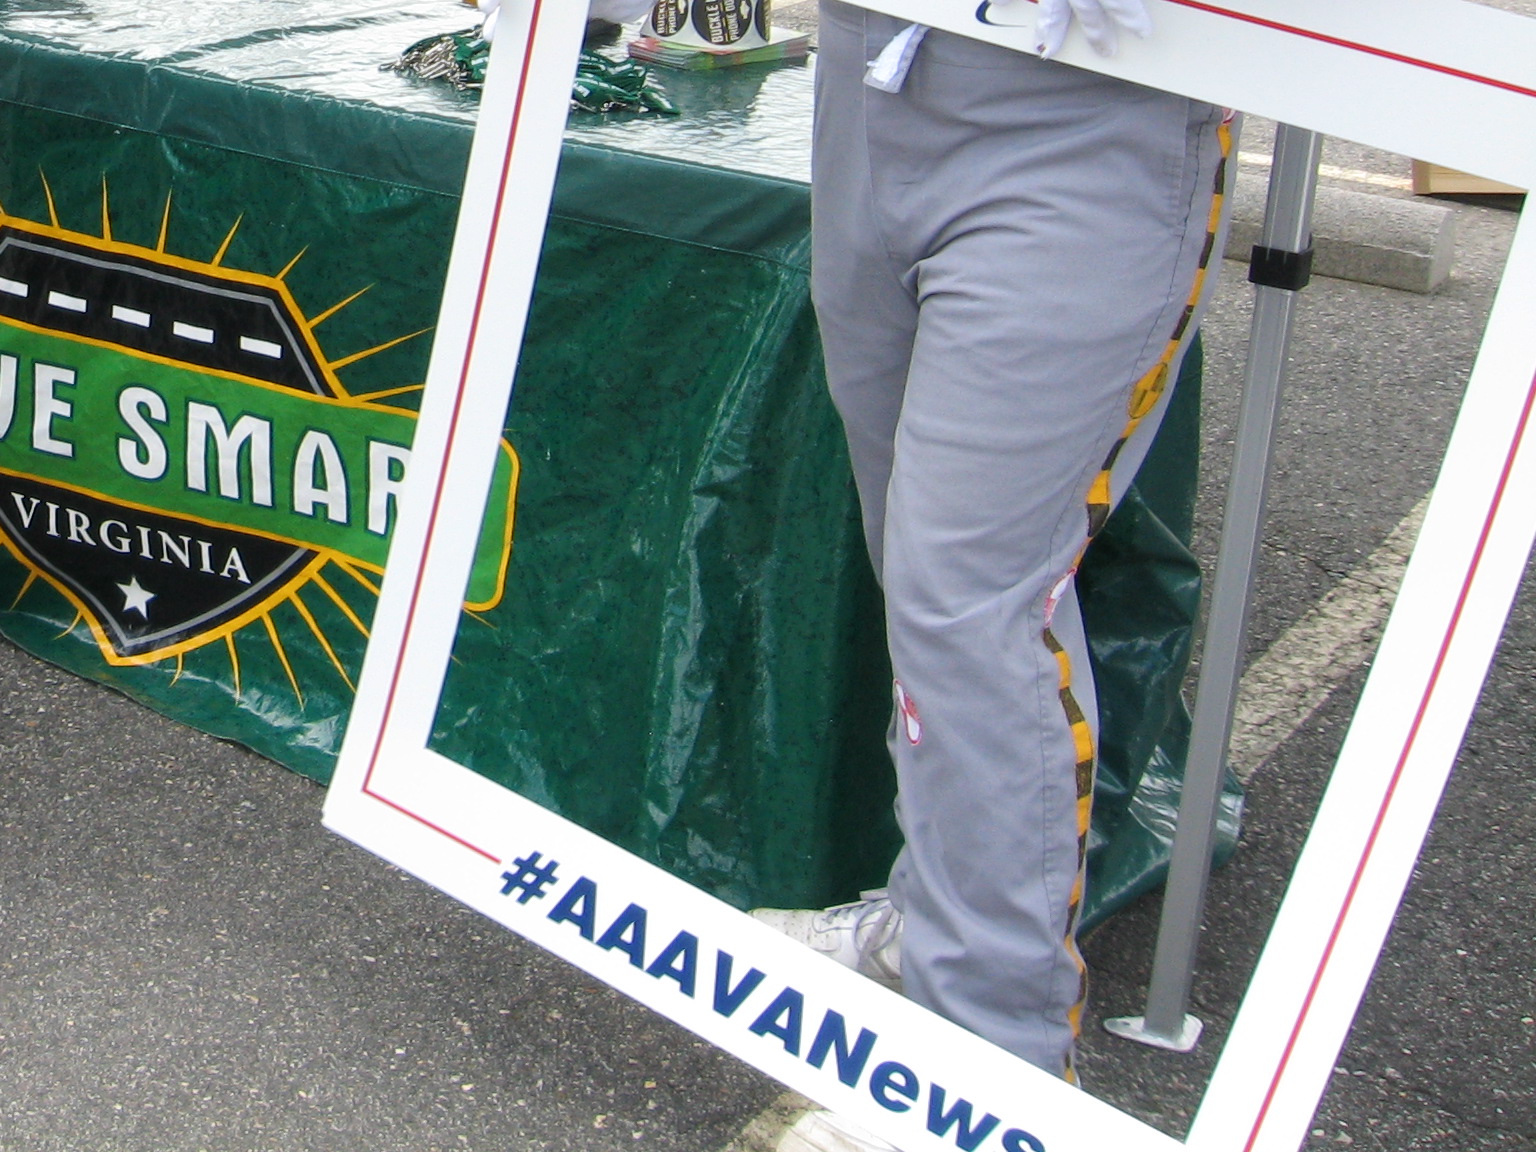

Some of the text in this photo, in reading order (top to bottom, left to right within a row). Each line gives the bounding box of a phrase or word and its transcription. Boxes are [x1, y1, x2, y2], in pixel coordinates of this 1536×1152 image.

[706, 4, 724, 43] BUCKLE
[725, 12, 741, 41] PHONE
[116, 383, 416, 538] SMAR
[11, 492, 252, 585] VIRGINIA
[500, 851, 1047, 1152] #AAAVANews
